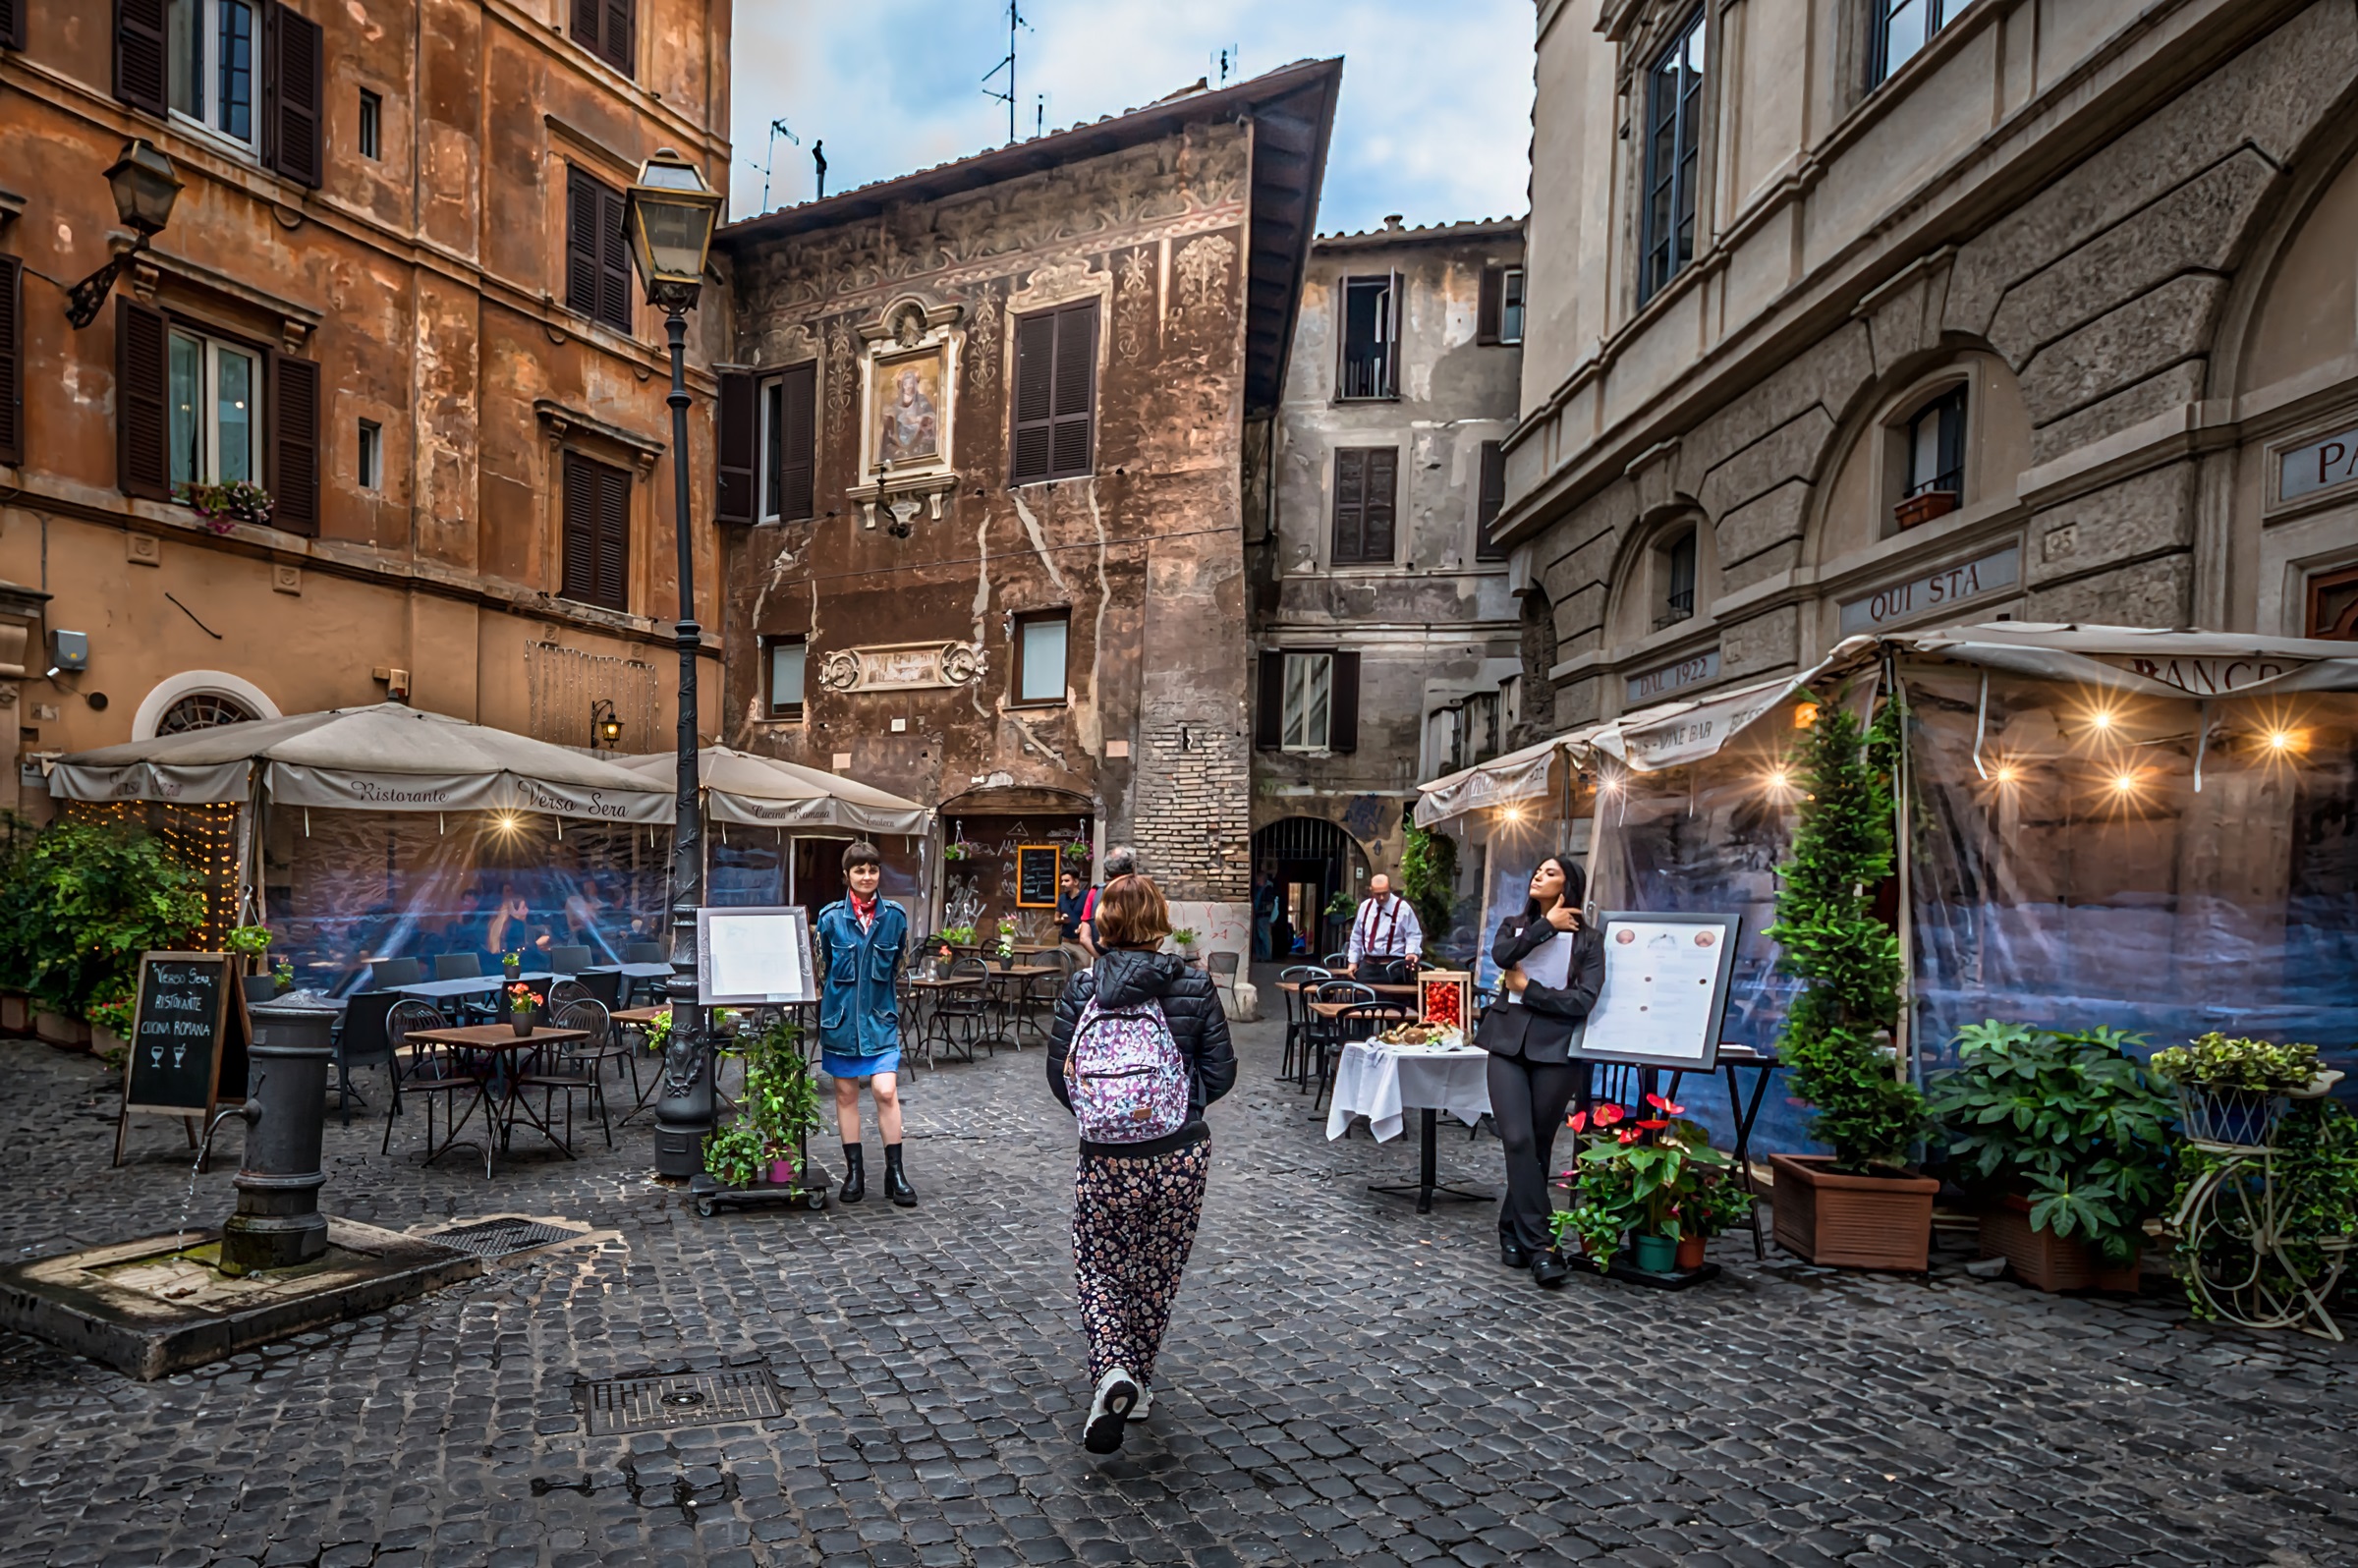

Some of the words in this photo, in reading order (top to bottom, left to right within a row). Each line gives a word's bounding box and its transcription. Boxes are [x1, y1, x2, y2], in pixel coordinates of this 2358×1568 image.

[1870, 585, 1912, 623] QUI
[1929, 563, 1981, 603] STA
[1640, 671, 1665, 697] DAL
[1675, 657, 1708, 686] 1922
[1688, 720, 1713, 743] BAR
[350, 779, 450, 804] Ristorante
[517, 779, 578, 812] Verso
[588, 792, 630, 817] Sera
[752, 805, 785, 819] Cucina
[788, 806, 830, 819] Romana
[863, 812, 895, 828] Enoteca
[155, 992, 202, 1011] RISTORANTE
[173, 1021, 211, 1036] ROMANA
